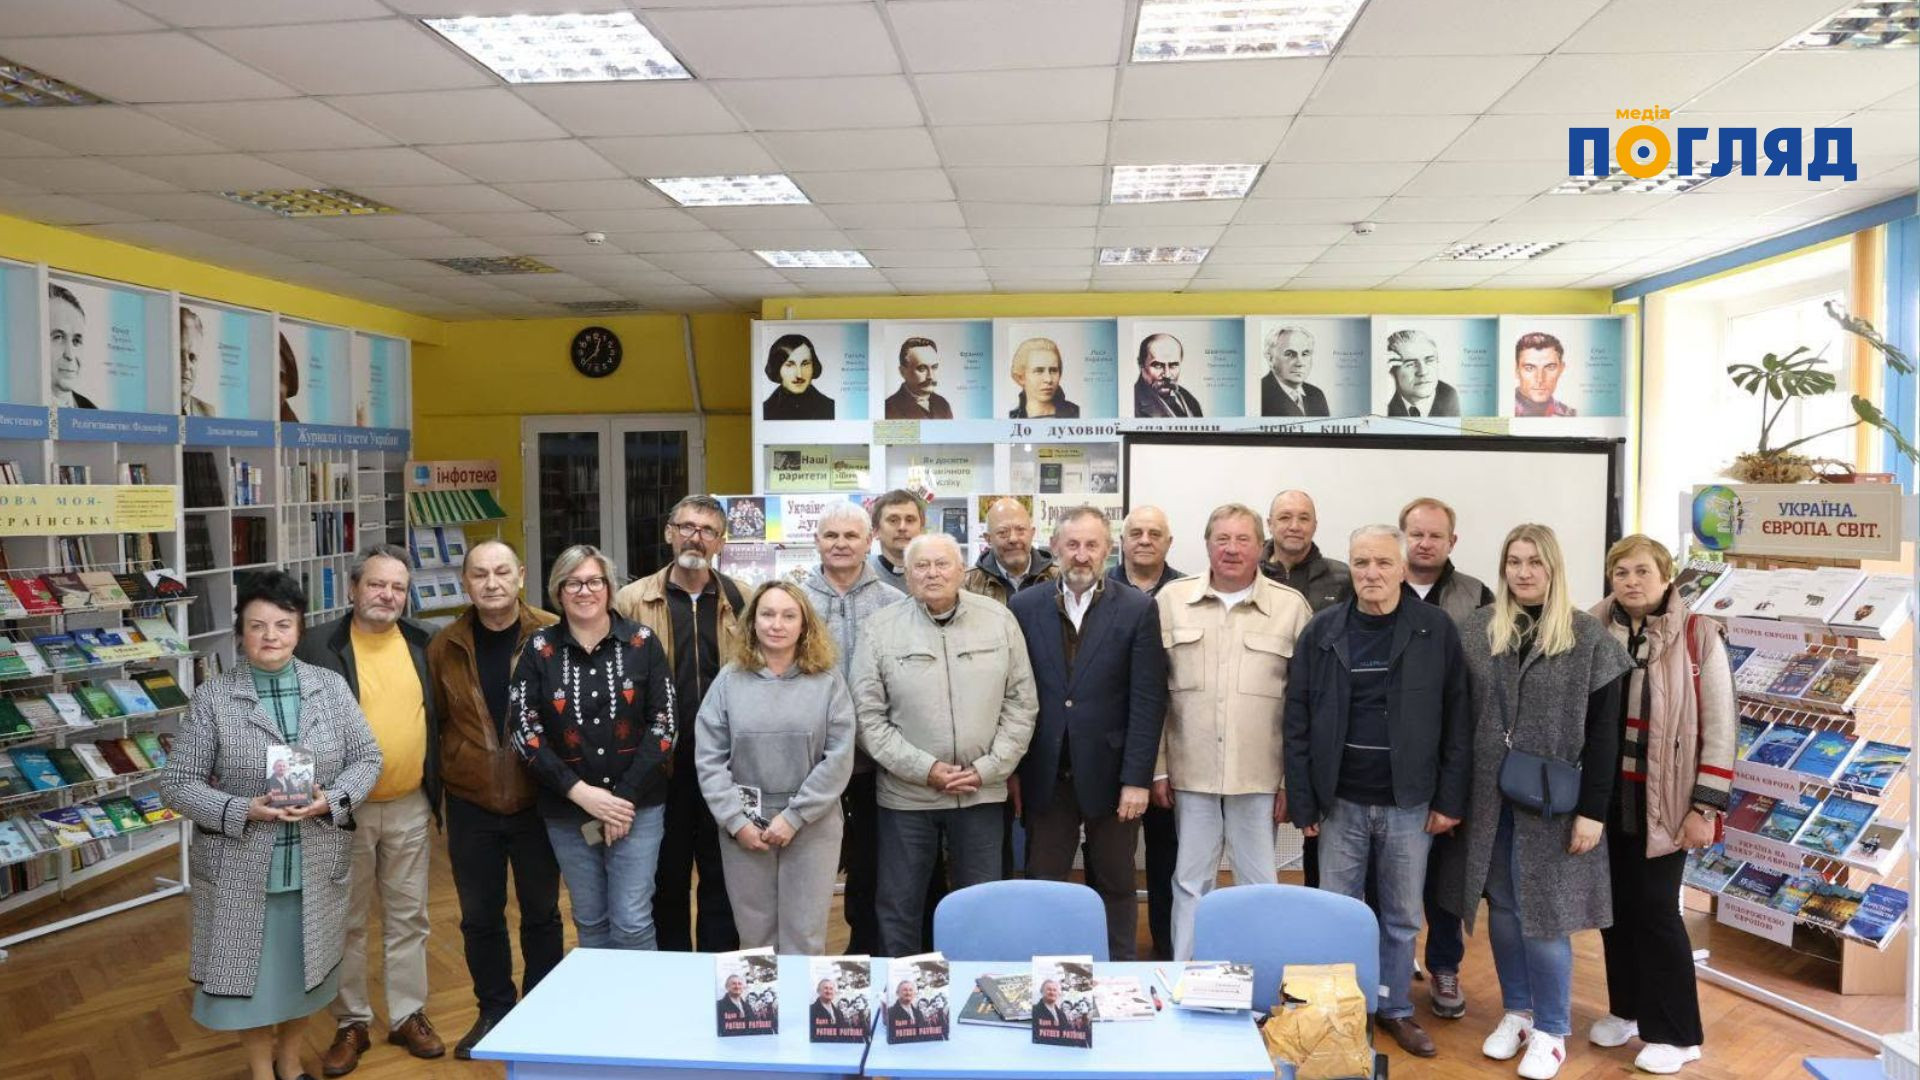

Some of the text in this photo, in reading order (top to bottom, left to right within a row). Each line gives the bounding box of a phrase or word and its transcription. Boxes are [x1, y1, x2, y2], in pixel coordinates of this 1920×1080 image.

[1010, 423, 1032, 437] До
[1047, 422, 1120, 439] духовної
[802, 455, 828, 465] Наші
[437, 467, 497, 486] інфотека
[778, 471, 827, 483] раритети
[1779, 500, 1857, 518] УКРАЇНА.
[0, 513, 111, 527] РАЇНСЬКА
[1762, 520, 1881, 538] ЄВРОПА. СВІТ.
